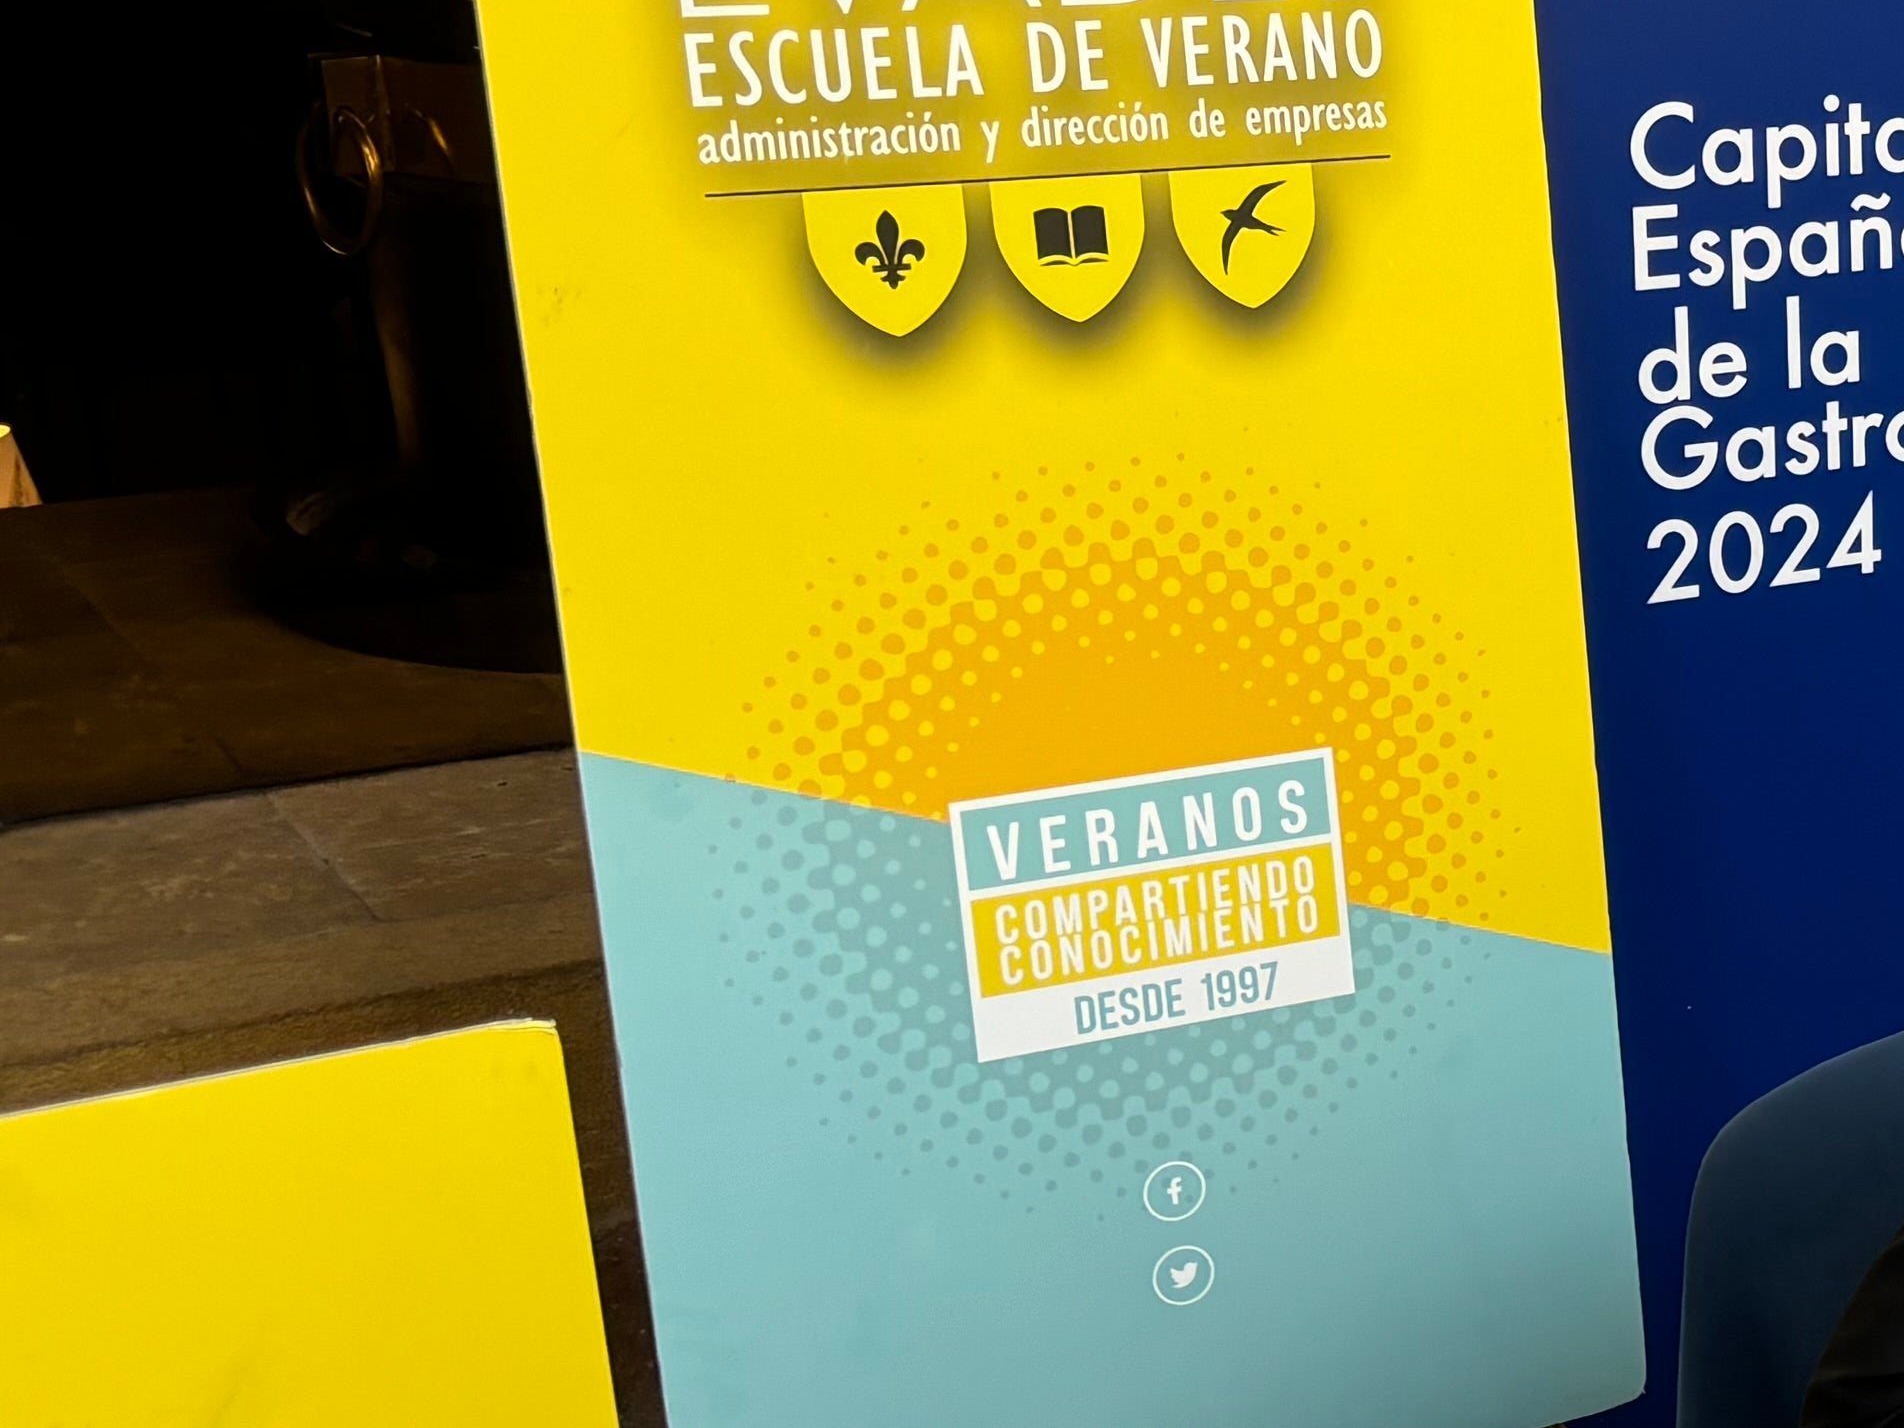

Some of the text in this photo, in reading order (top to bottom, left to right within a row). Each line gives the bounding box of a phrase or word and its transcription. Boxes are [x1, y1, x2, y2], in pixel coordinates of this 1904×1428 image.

[683, 8, 1383, 108] ESCUELA DE VERANO
[697, 98, 1388, 165] administración y dirección de empresas
[1637, 295, 1861, 404] de la
[1646, 489, 1882, 605] 2024
[986, 778, 1308, 880] VERANOS
[994, 856, 1315, 944] COMPARTIENDO
[999, 894, 1320, 987] CONOCIMIENTO
[1074, 960, 1280, 1036] DESDE 1997
